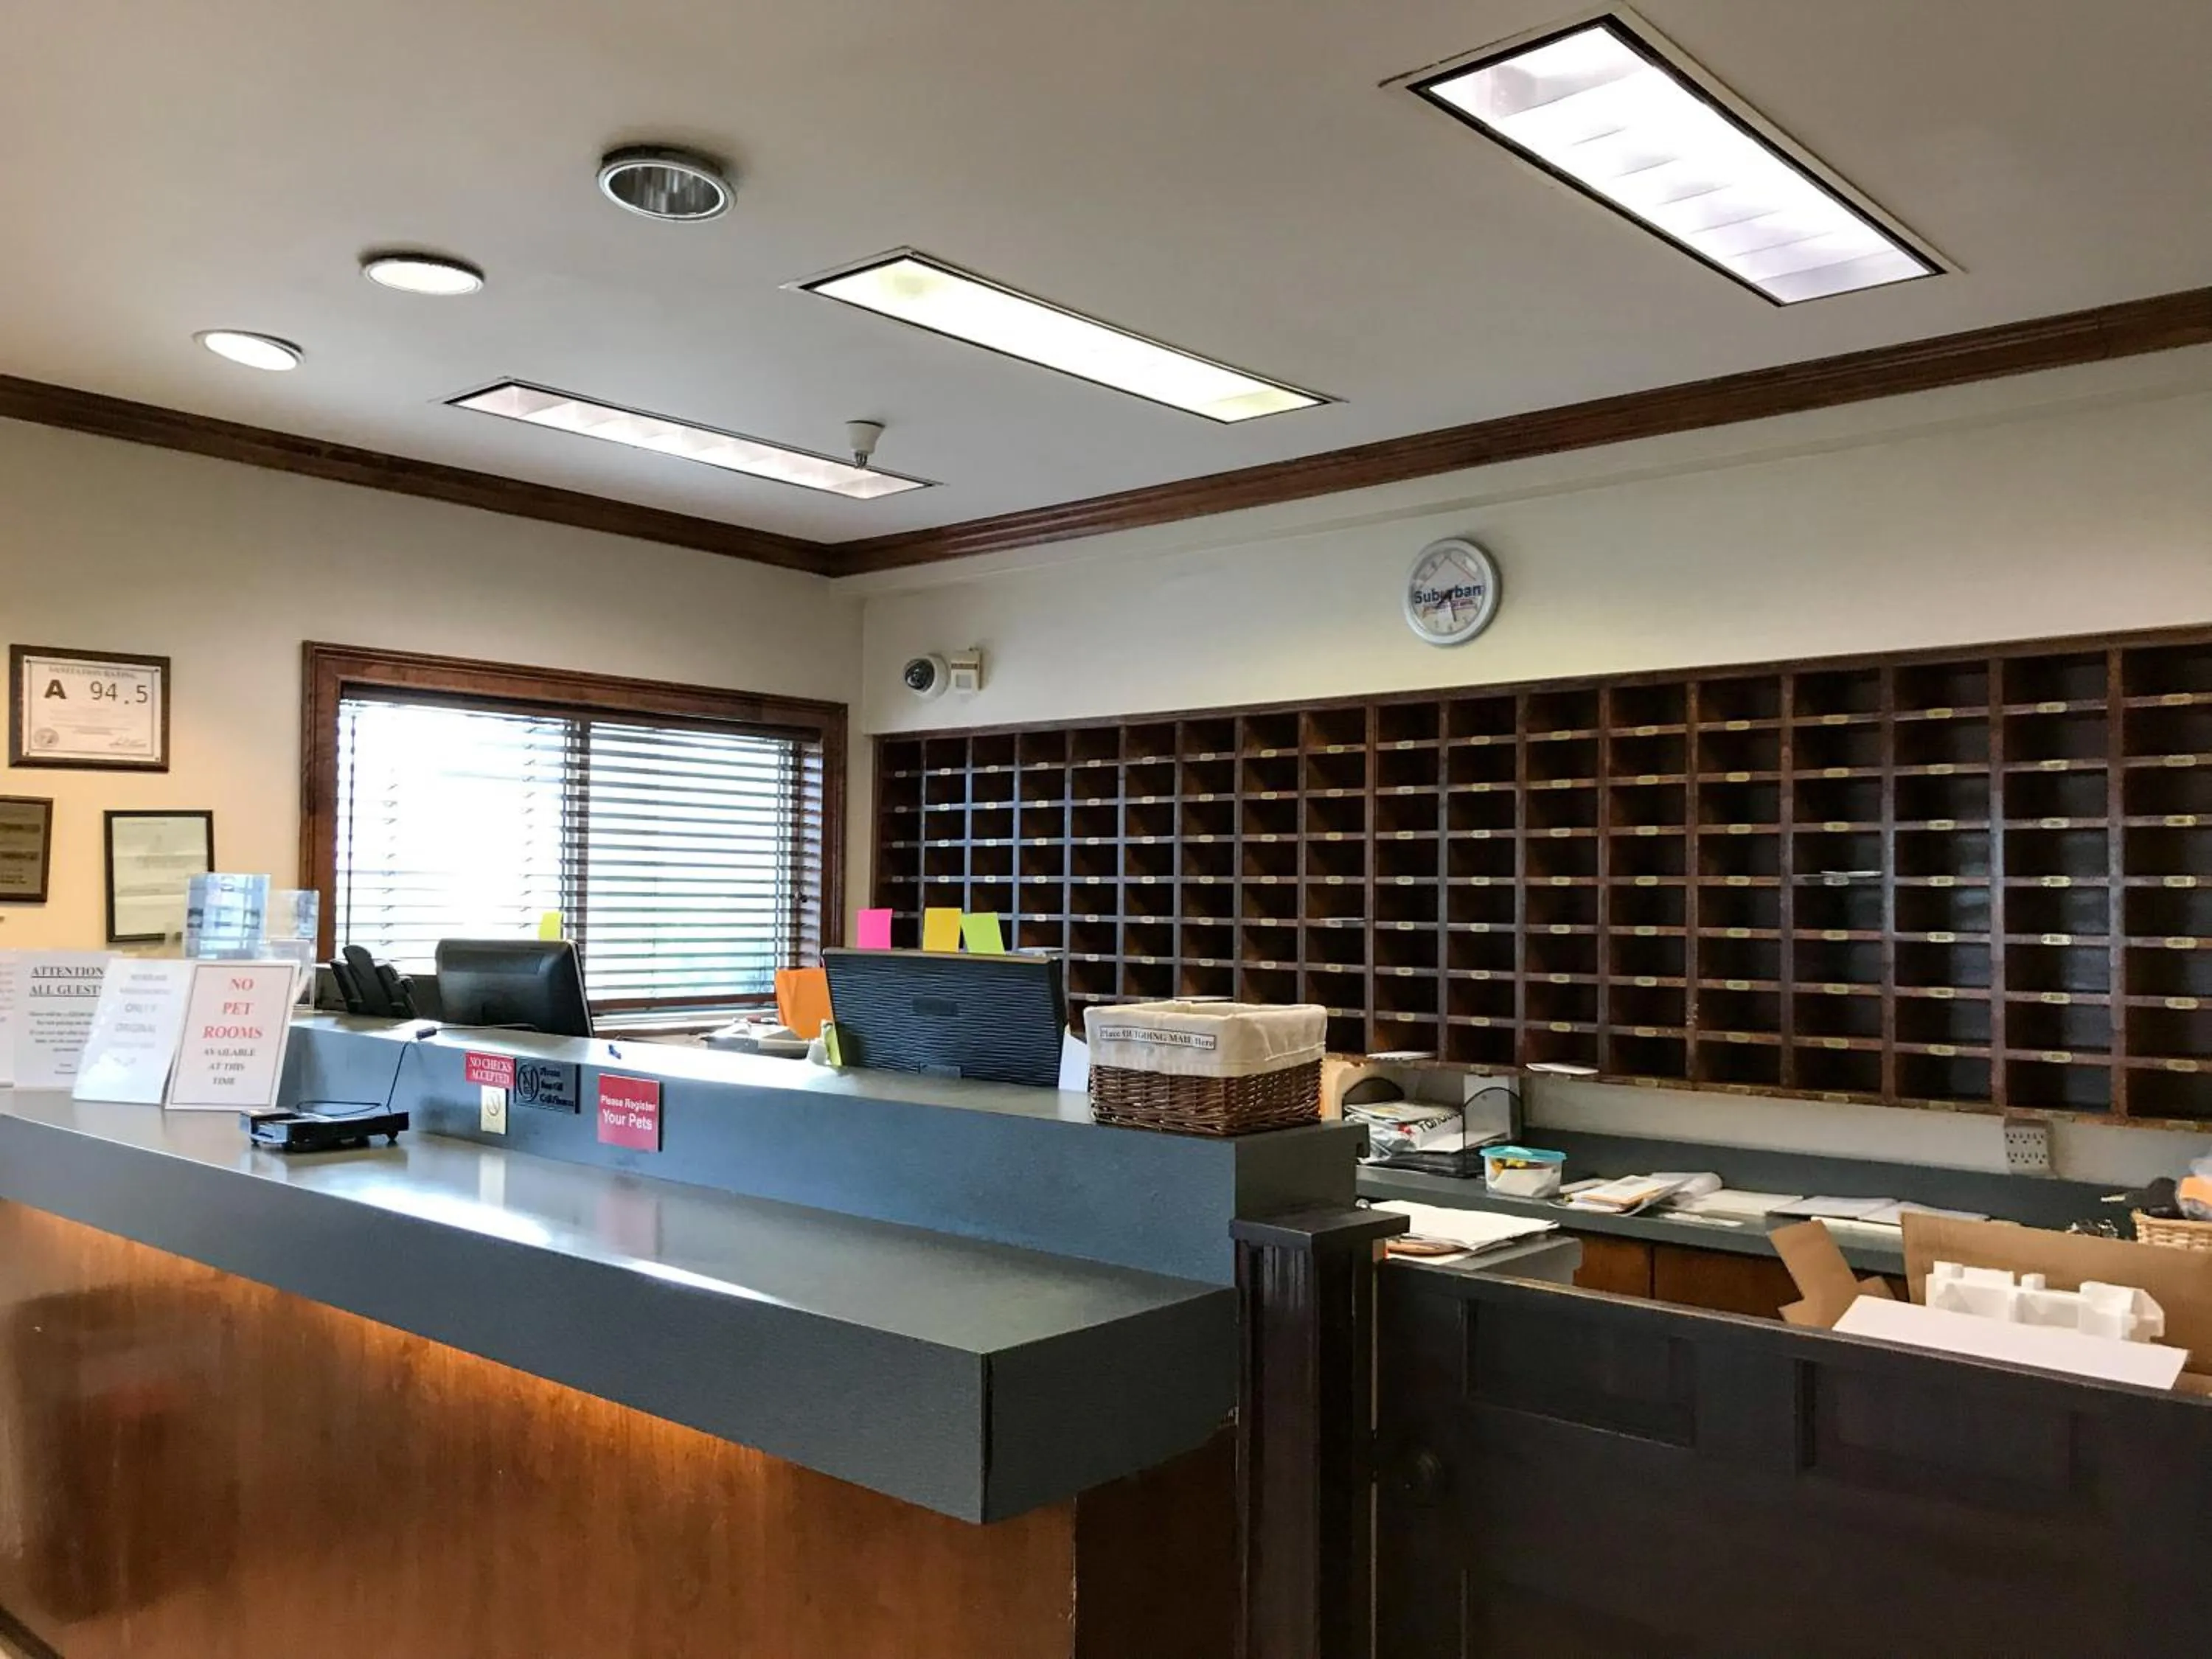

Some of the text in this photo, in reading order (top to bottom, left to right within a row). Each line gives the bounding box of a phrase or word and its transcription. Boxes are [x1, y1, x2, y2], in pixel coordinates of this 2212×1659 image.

[44, 678, 148, 703] A 94.5
[32, 967, 104, 977] ATTENTION
[30, 984, 102, 995] ALL GUEST
[229, 978, 254, 991] NO
[223, 1002, 254, 1015] PET
[202, 1026, 263, 1038] ROOMS
[204, 1048, 256, 1057] AVAILABLE
[208, 1062, 221, 1071] AT
[469, 1057, 512, 1072] NO CHECKS
[472, 1070, 509, 1085] ACCEPTED
[601, 1095, 655, 1112] Please Register
[602, 1109, 653, 1130] Your Pets
